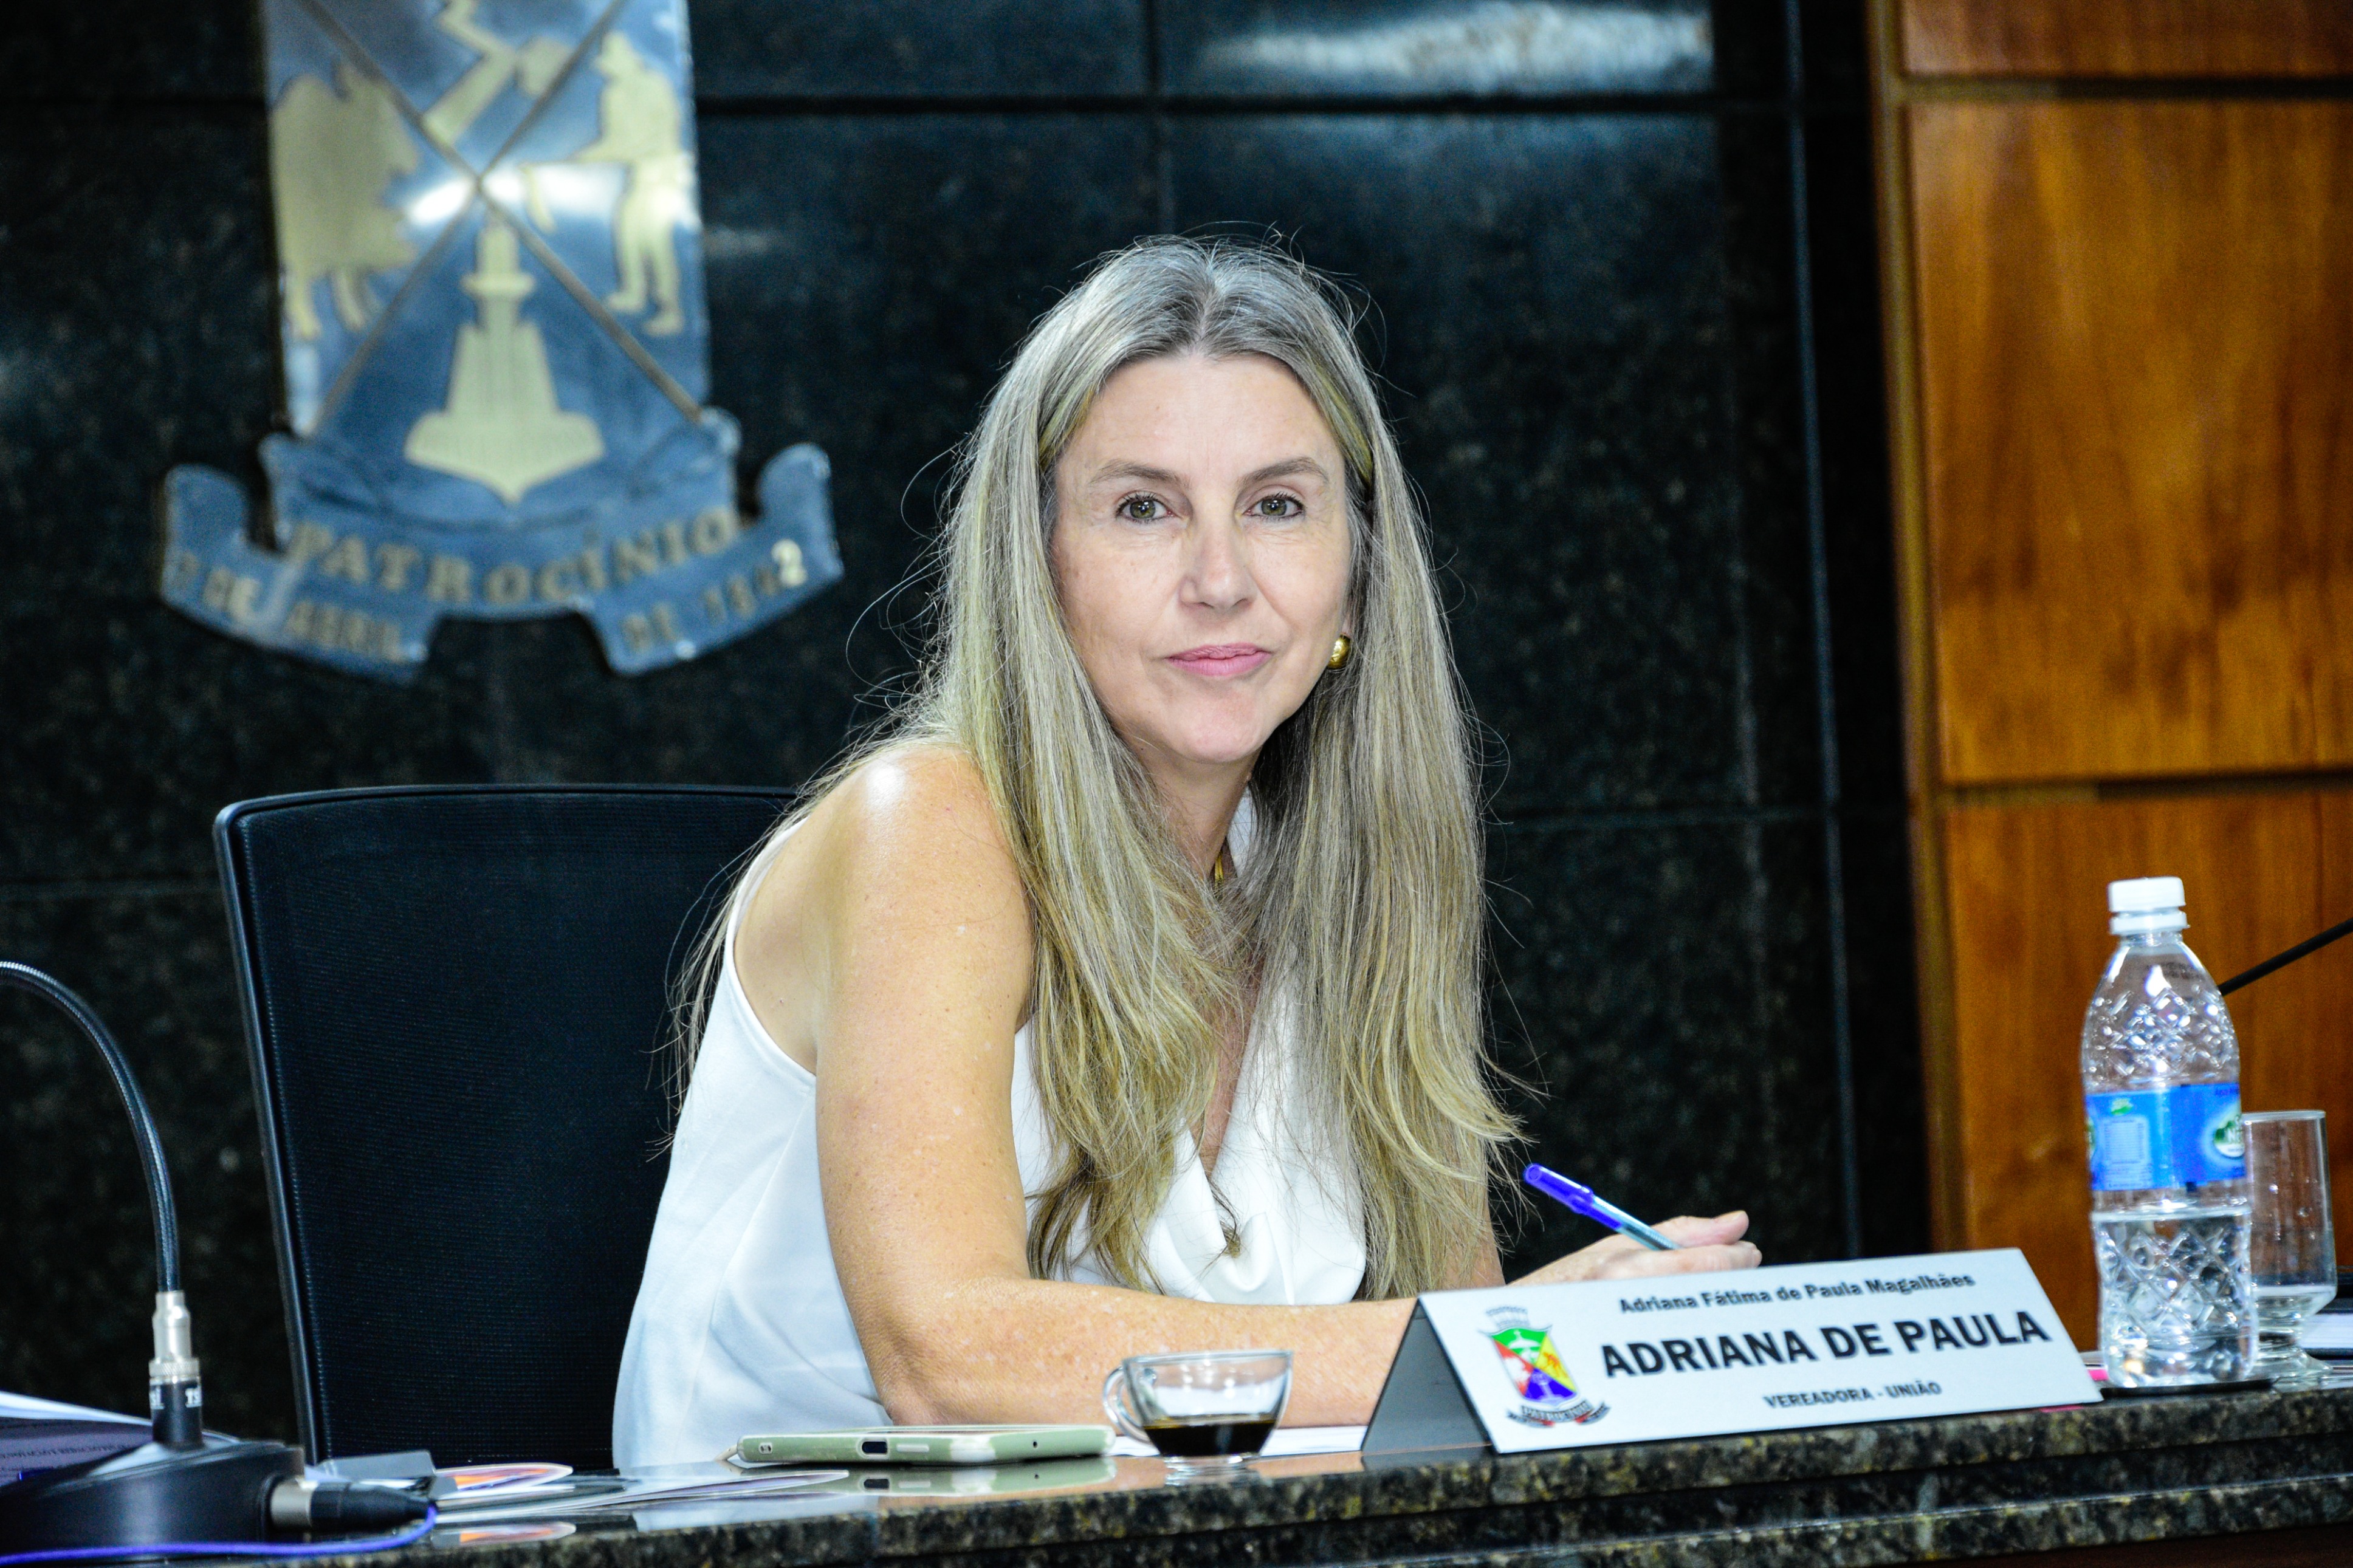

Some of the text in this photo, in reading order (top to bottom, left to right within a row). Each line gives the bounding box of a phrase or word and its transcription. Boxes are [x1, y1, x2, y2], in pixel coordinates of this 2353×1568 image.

[1620, 1273, 1975, 1313] Adriana Fátima de Paula Magalhães
[1601, 1310, 2052, 1377] ADRIANA DE PAULA
[1762, 1388, 1874, 1408] VEREADORA
[1884, 1378, 1942, 1398] UNIÃO
